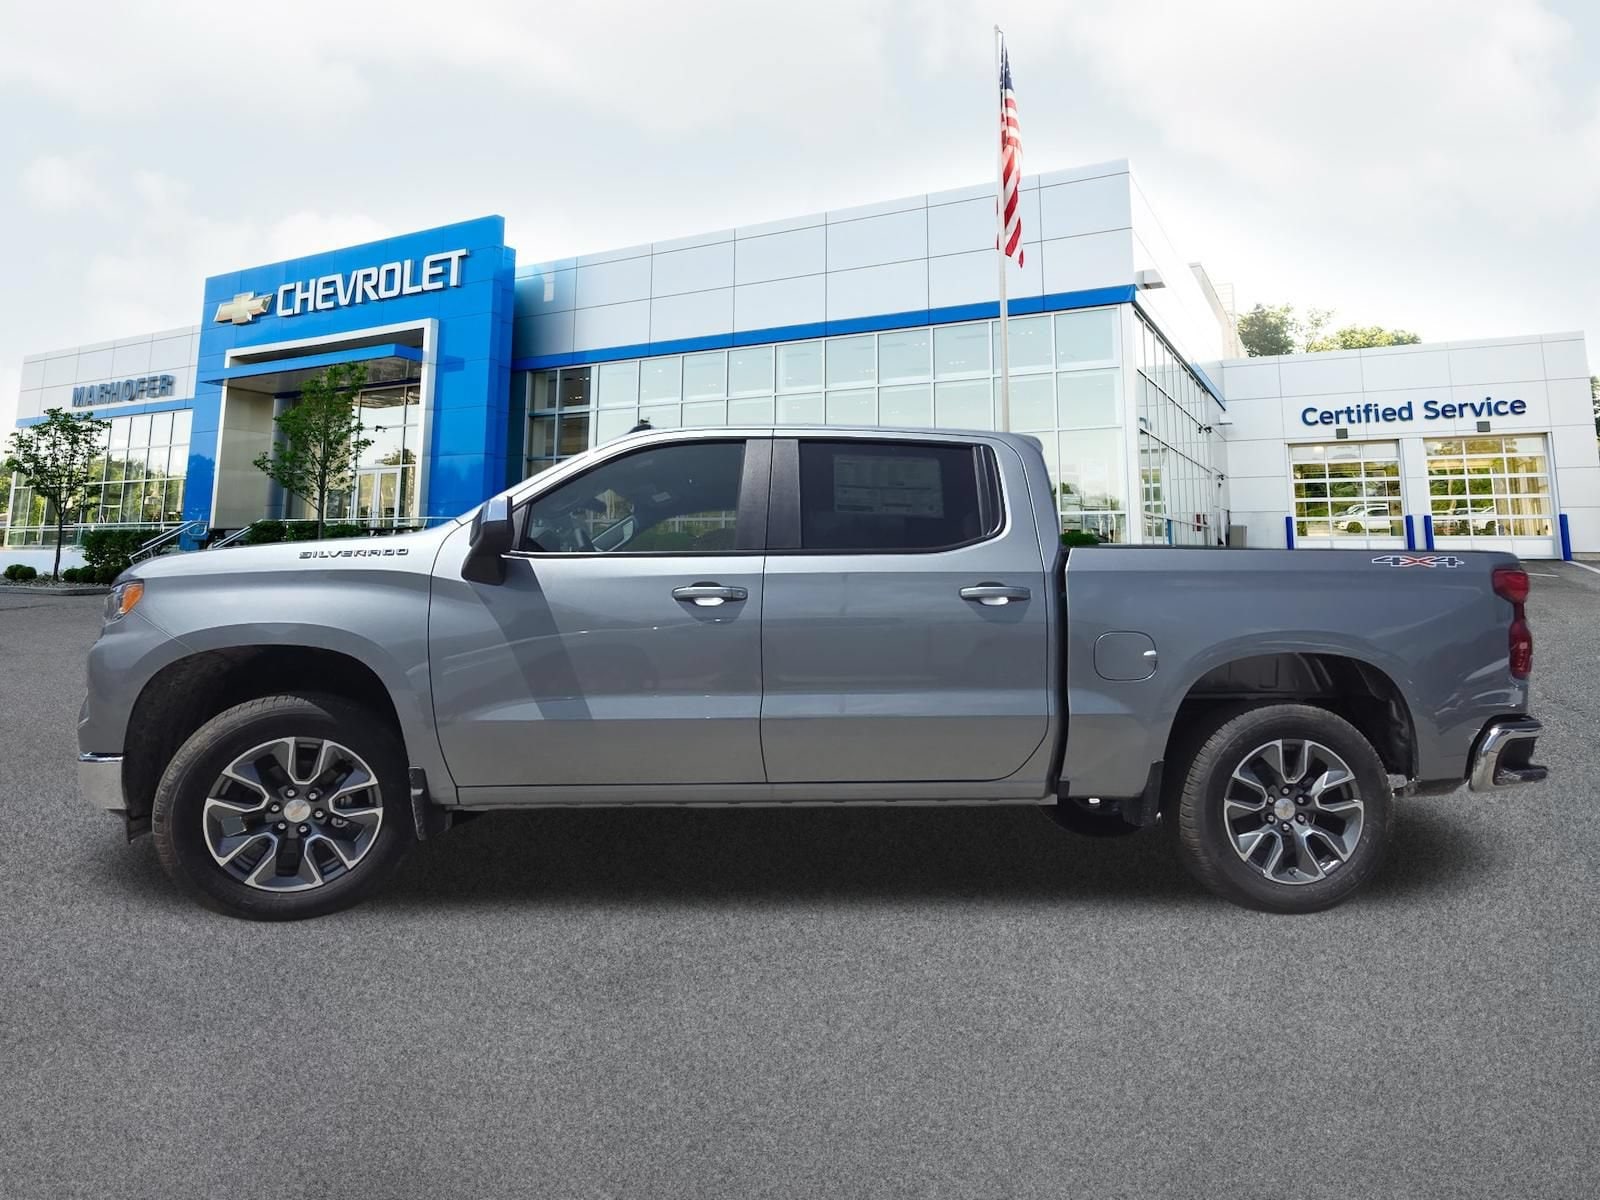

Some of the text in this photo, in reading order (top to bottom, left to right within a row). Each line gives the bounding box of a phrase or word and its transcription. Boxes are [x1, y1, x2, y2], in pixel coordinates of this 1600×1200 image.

[276, 248, 469, 318] CHEVROLET
[72, 374, 175, 407] MARHOFER
[1301, 397, 1527, 427] Certified Service
[299, 548, 409, 560] SILVERADO
